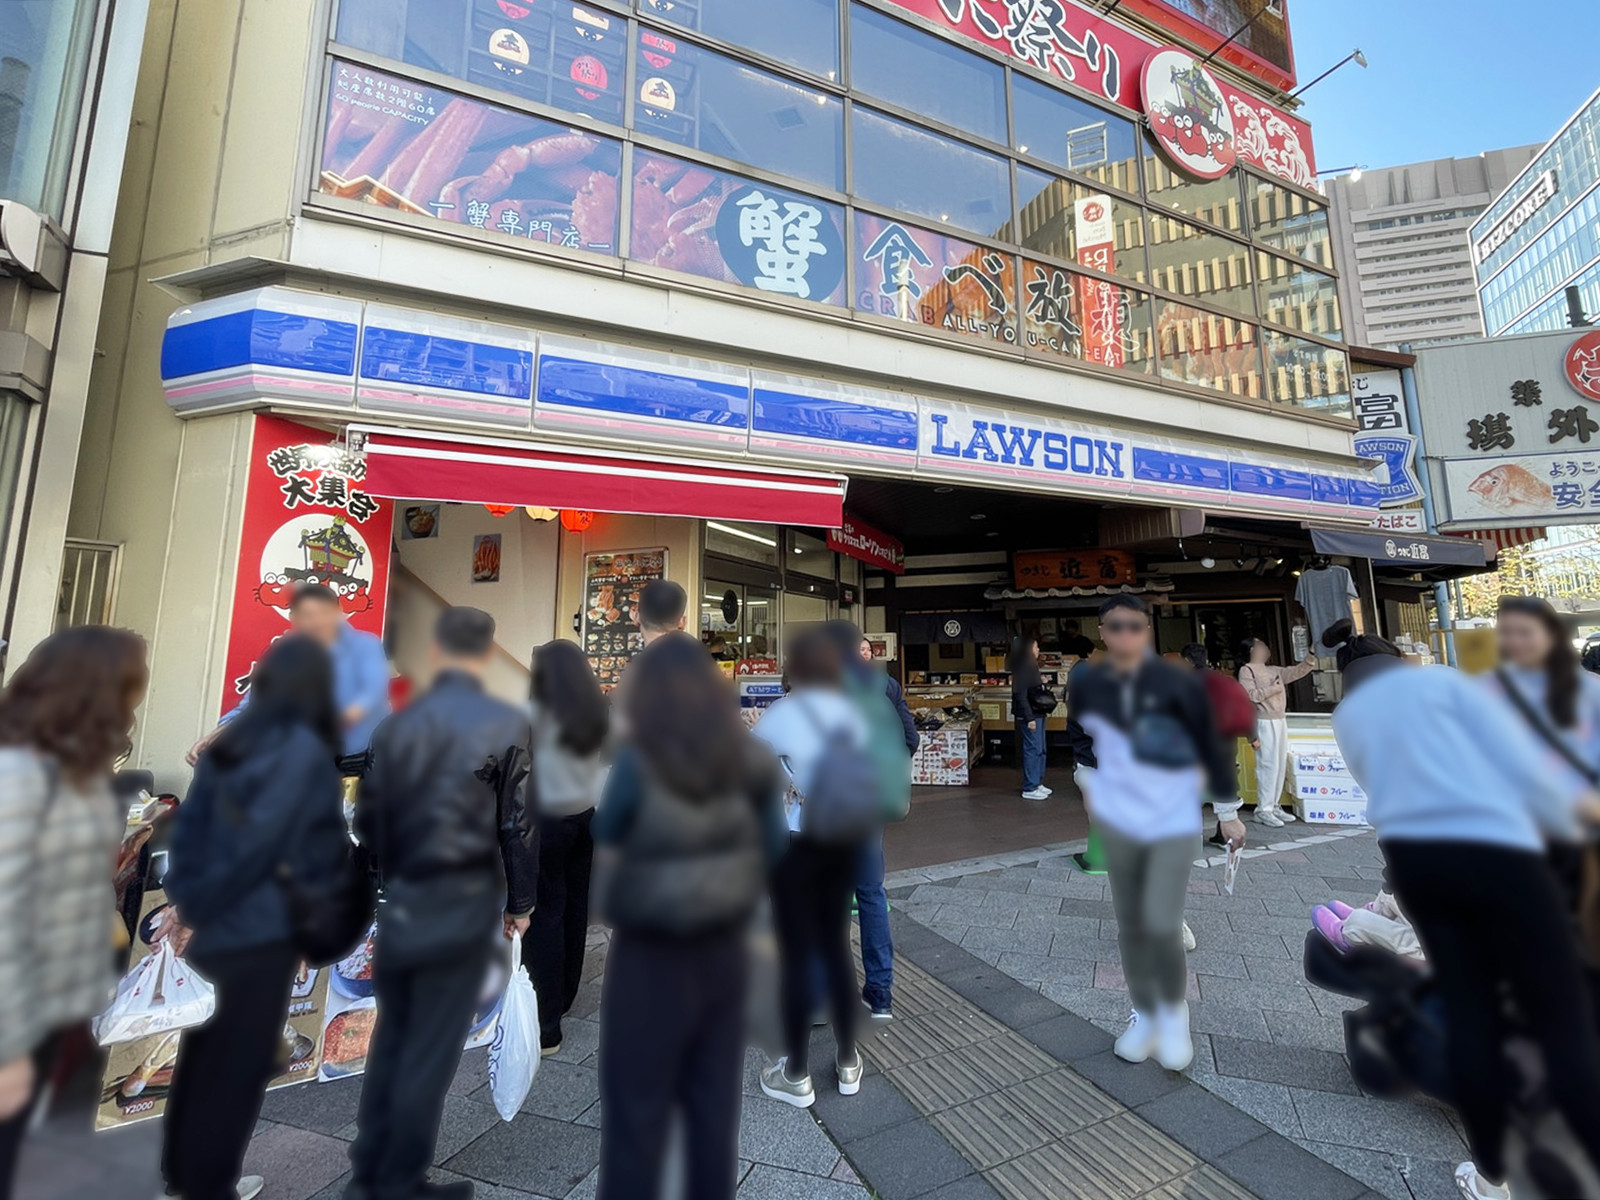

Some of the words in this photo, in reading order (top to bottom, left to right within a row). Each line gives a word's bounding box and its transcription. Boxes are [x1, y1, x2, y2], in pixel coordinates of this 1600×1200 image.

[336, 92, 349, 103] 60
[382, 106, 429, 126] CAPACITY
[1480, 184, 1549, 261] BIZCORE
[736, 190, 827, 299] 蟹
[864, 222, 1140, 352] 食べ放題
[858, 290, 935, 326] CRAB
[931, 413, 1124, 478] LAWSON
[1355, 441, 1405, 453] AWSON
[1466, 404, 1600, 451] 場外
[1380, 483, 1410, 495] TION
[1550, 460, 1600, 477] ようこ
[281, 474, 380, 521] 大集合
[1377, 515, 1417, 528] たばこ
